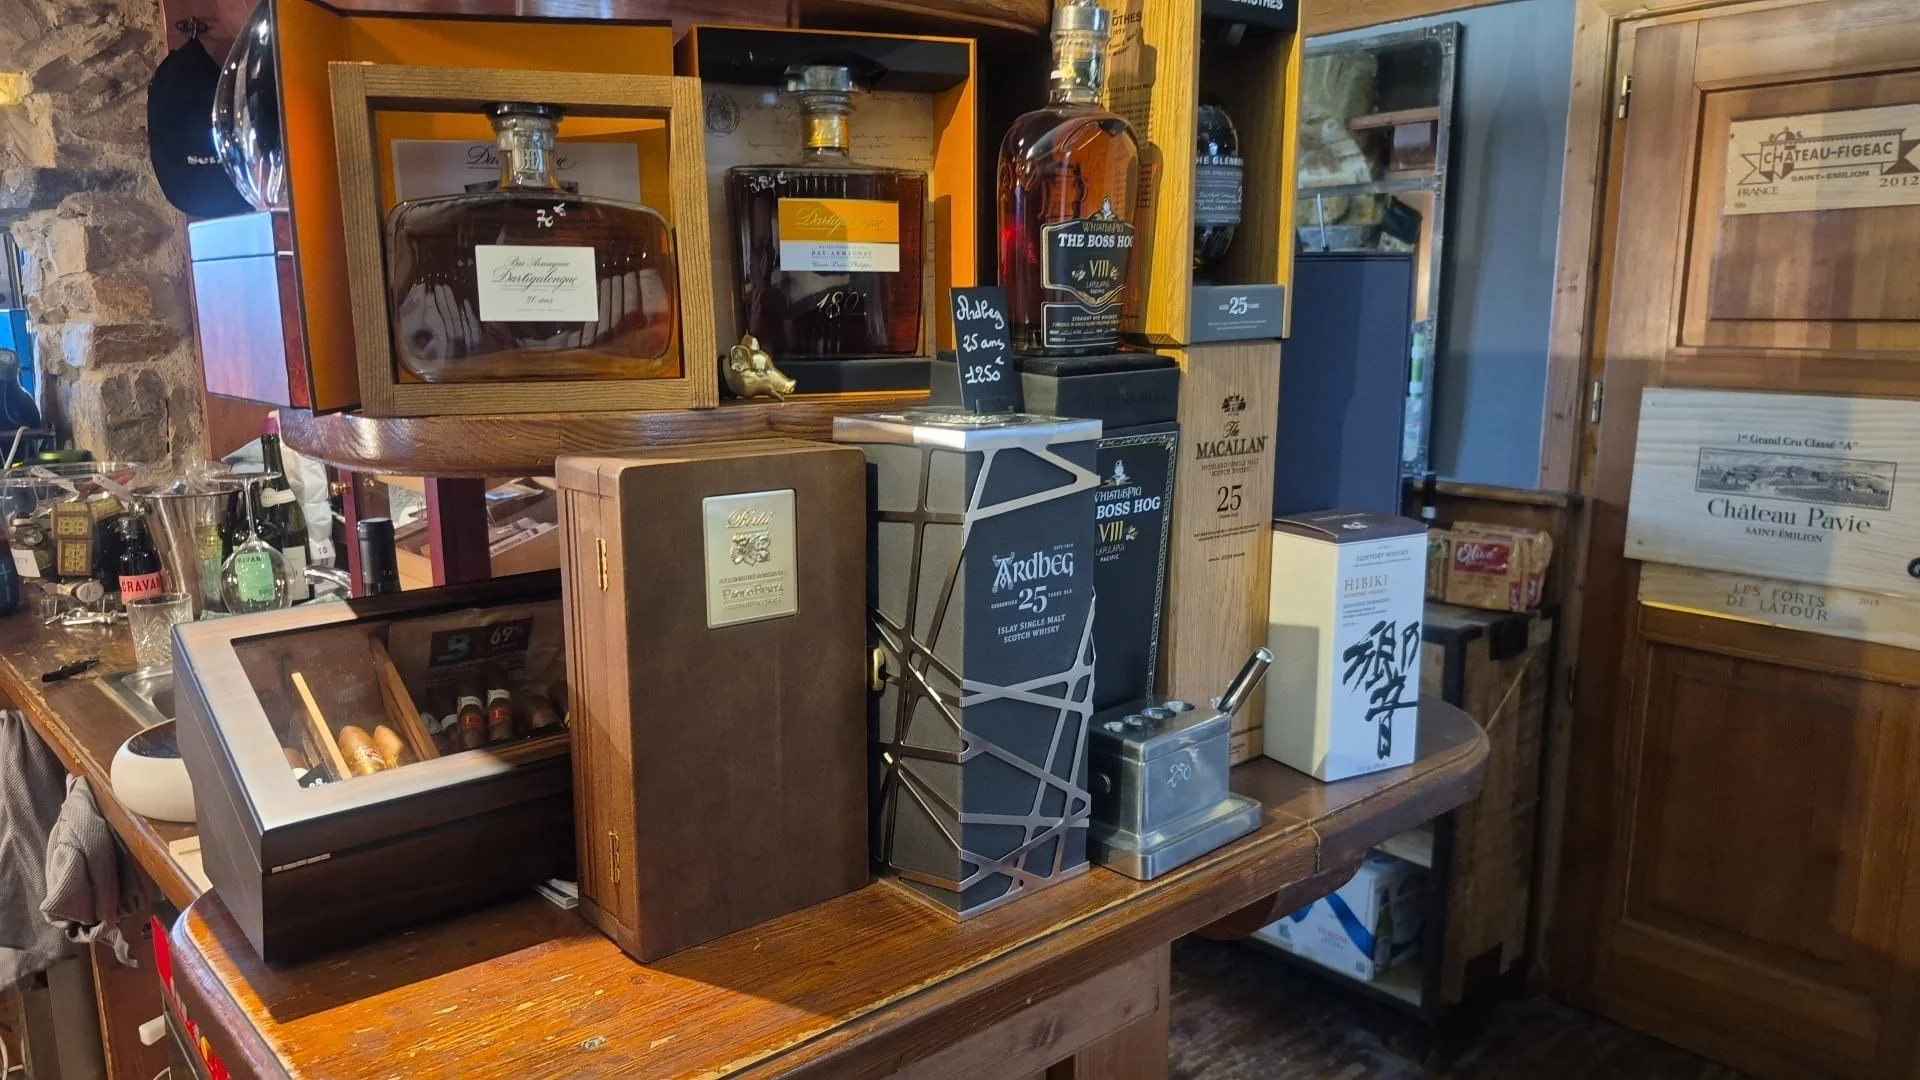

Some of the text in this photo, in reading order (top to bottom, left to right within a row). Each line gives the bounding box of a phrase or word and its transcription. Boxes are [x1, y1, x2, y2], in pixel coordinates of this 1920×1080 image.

[1737, 185, 1779, 197] FRANCE
[1879, 175, 1919, 188] 2012
[1057, 233, 1085, 248] THE
[1087, 234, 1115, 248] BOSS
[1089, 259, 1110, 278] VIII
[1229, 296, 1249, 314] 25
[963, 333, 1006, 353] 25 ans
[1223, 420, 1241, 439] The
[1195, 435, 1268, 460] MACALLAN
[1750, 434, 1781, 446] Grand
[1783, 437, 1803, 447] Cru
[1804, 438, 1837, 450] Classé
[1096, 496, 1161, 520] BOSS HOG
[1216, 484, 1242, 512] 25
[1707, 499, 1872, 534] Château Pavie
[1099, 520, 1124, 543] VIII
[1344, 574, 1389, 592] HIBIKI
[1018, 585, 1048, 614] 25
[1733, 583, 1826, 608] LES FORTS
[1726, 595, 1829, 622] DE LATOUR
[998, 614, 1066, 635] ISLAY SINGLE MALT
[1003, 625, 1061, 644] SCOTCH WHISKY
[1168, 763, 1192, 788] 250
